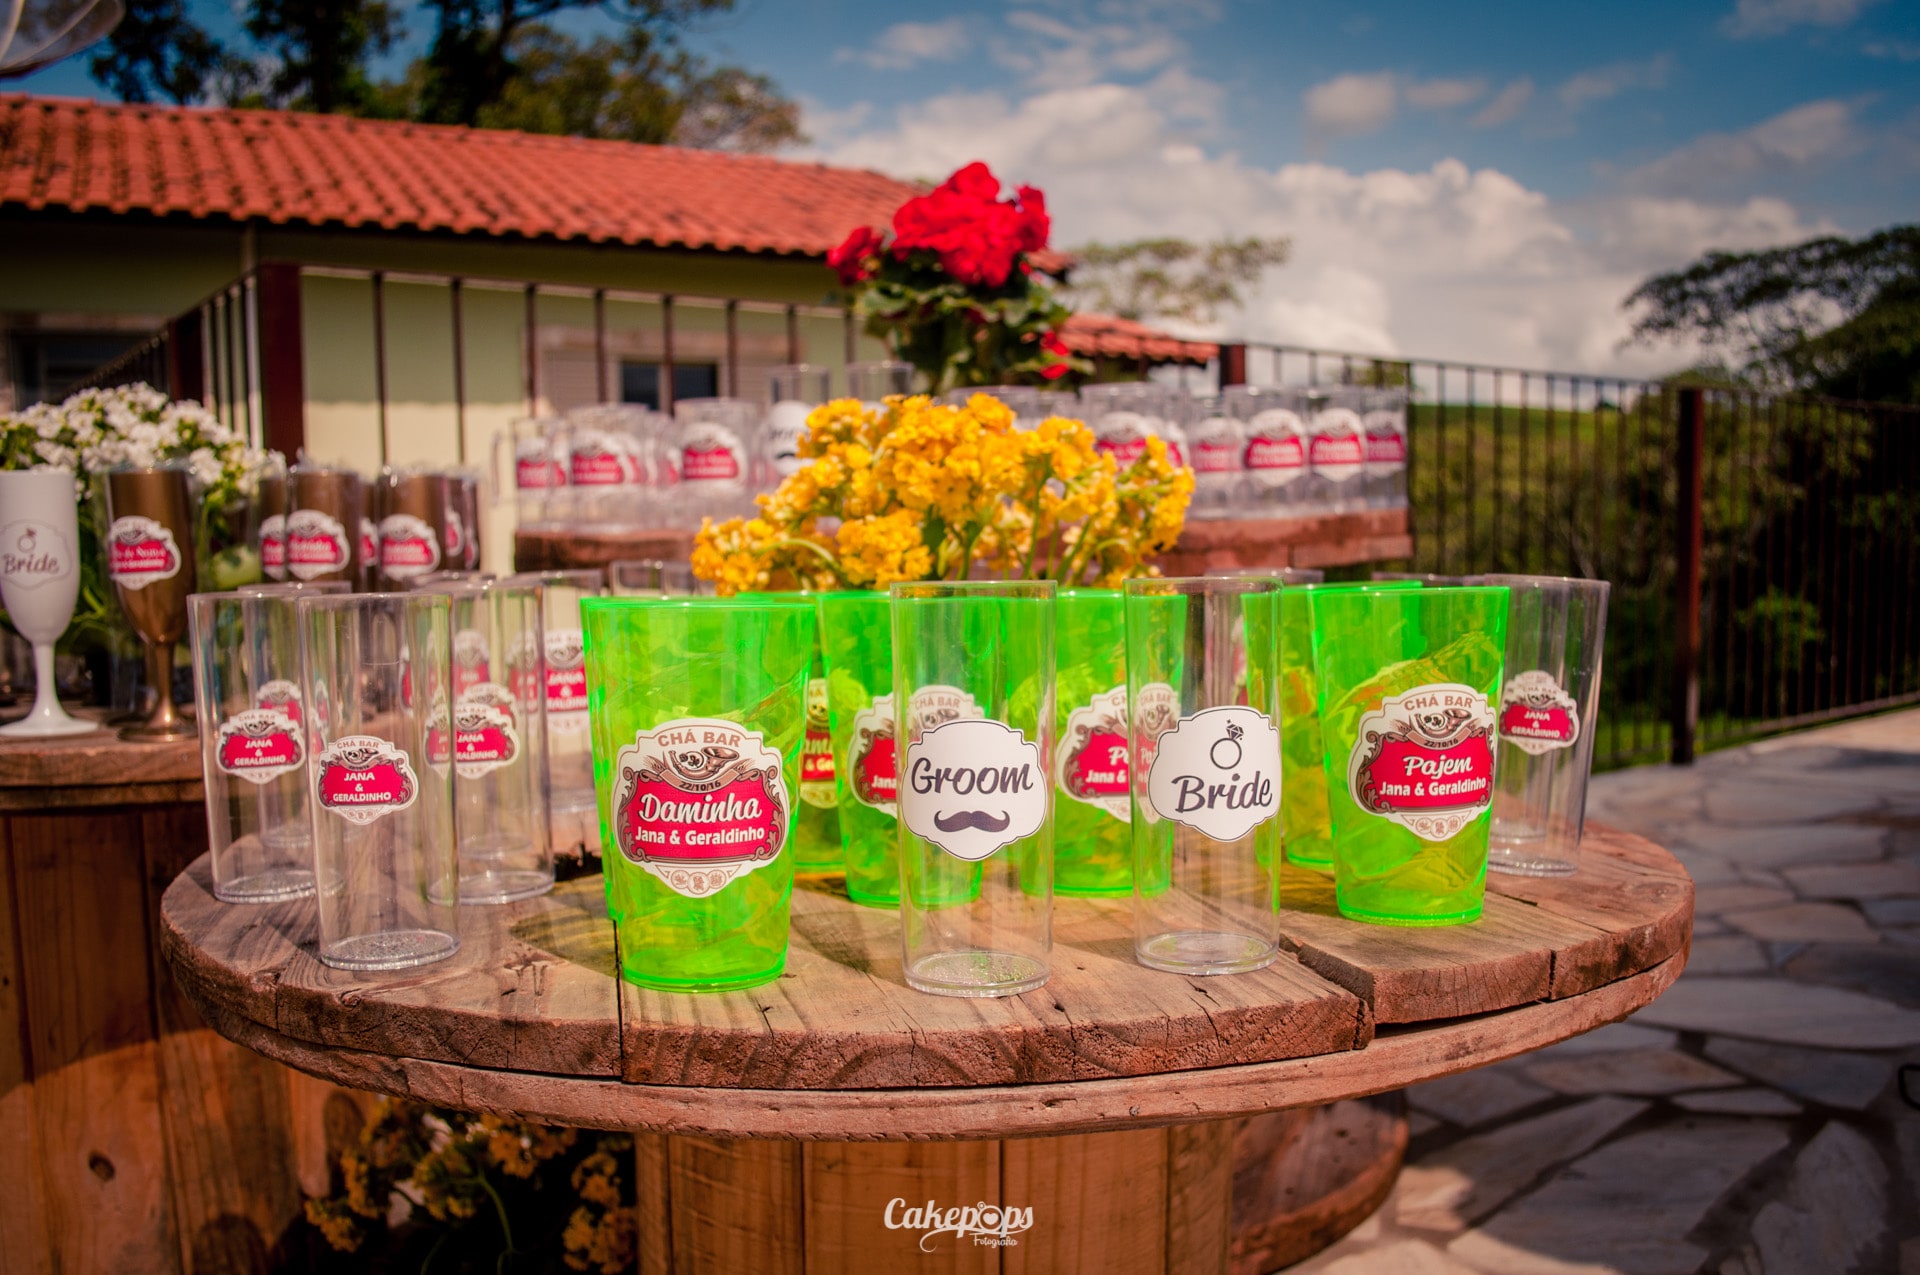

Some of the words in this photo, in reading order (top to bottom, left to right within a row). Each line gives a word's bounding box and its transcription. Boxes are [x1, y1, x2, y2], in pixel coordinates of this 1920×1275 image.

[3, 552, 60, 575] Bride
[938, 697, 960, 708] BAR
[1404, 695, 1440, 711] CHÁ
[1444, 696, 1473, 708] BAR
[1524, 711, 1551, 721] JANA
[1532, 720, 1540, 729] &
[1511, 725, 1560, 738] GERALDINHO
[245, 738, 273, 748] JANA
[458, 733, 485, 743] JANA
[658, 729, 696, 747] CHÁ
[703, 731, 741, 747] BAR
[1424, 738, 1459, 748] 22/10/16
[467, 742, 475, 751] &
[255, 748, 263, 757] &
[234, 754, 286, 766] GERALDINHO
[1402, 754, 1473, 779] Pajem
[344, 771, 375, 781] JANA
[911, 757, 1034, 796] Groom
[1085, 769, 1116, 784] Jana
[1116, 769, 1127, 784] &
[354, 783, 363, 792] &
[679, 780, 721, 791] 22/10/16
[1379, 781, 1411, 796] Jana
[1414, 782, 1425, 796] &
[1428, 777, 1487, 796] Geraldinho
[333, 791, 392, 802] GERALDINHO
[1171, 770, 1273, 814] Bride
[638, 792, 762, 824] Daminha
[635, 826, 665, 844] Jana
[669, 830, 680, 845] &
[685, 827, 765, 846] Geraldinho
